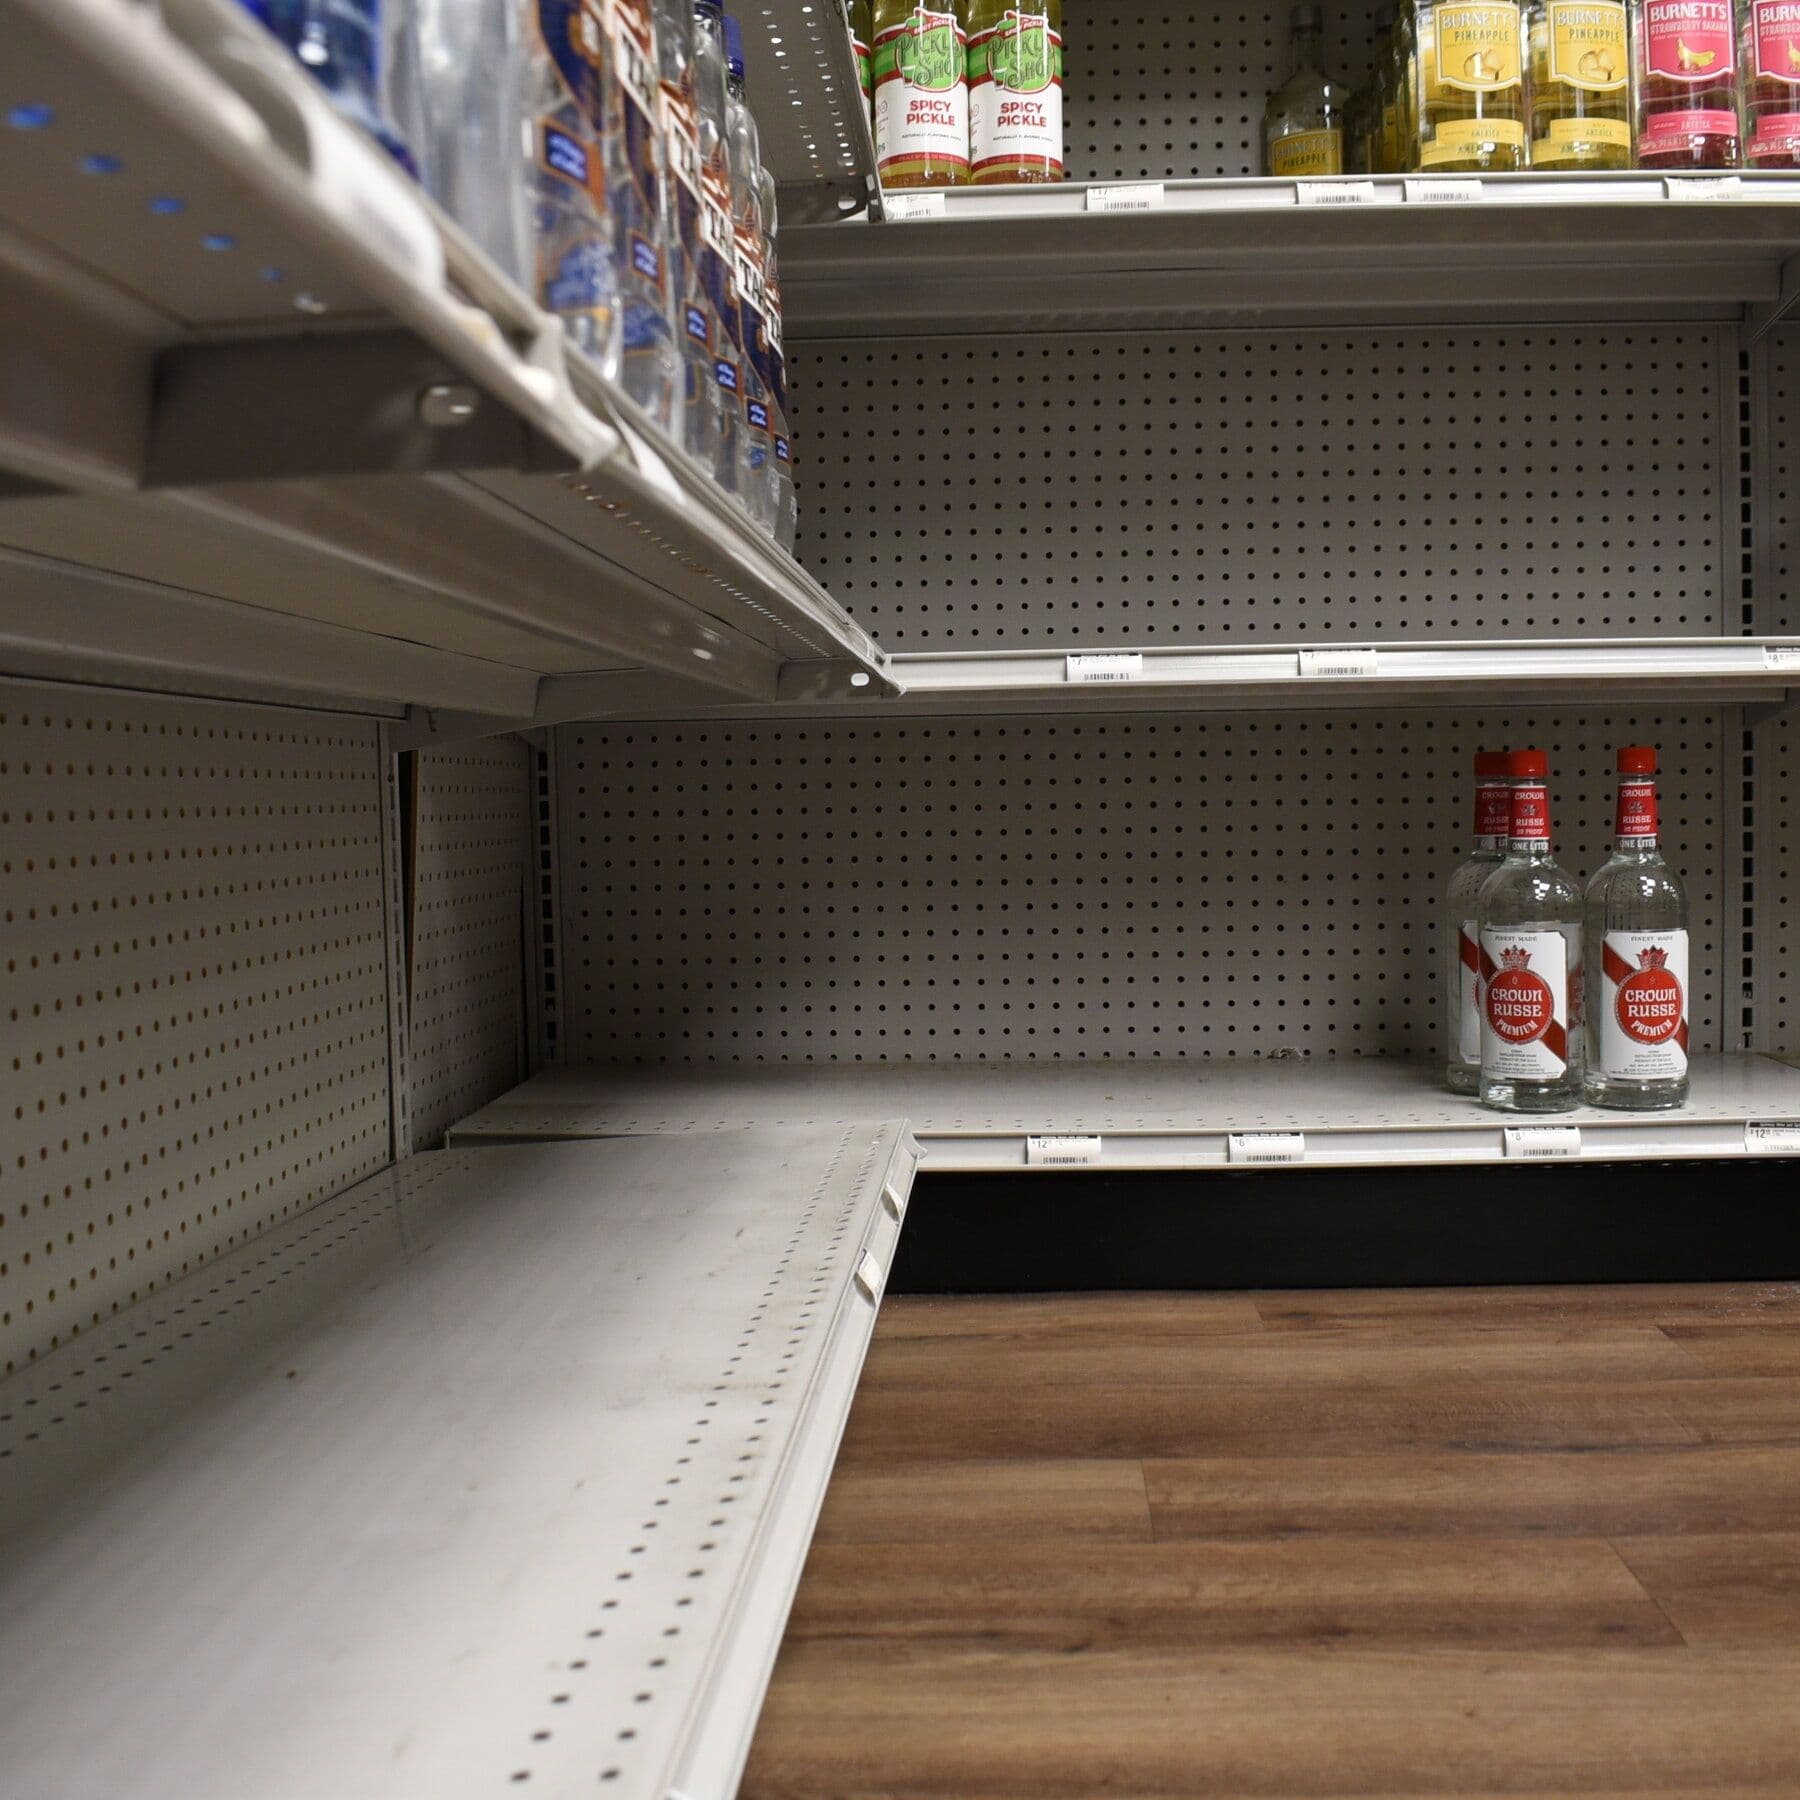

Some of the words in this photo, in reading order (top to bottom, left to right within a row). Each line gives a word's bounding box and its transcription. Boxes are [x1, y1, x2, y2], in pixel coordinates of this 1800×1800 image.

[1454, 30, 1509, 42] PINEAPPLE
[1569, 28, 1620, 42] PINEAPPLE
[909, 100, 951, 112] SPICY
[1001, 102, 1042, 113] SPICY
[906, 113, 955, 126] PICKLE
[997, 115, 1046, 127] PICKLE
[1514, 791, 1545, 800] CROWN
[1622, 789, 1652, 798] CROWN
[1515, 818, 1545, 827] RUSSE
[1622, 815, 1652, 824] RUSSE
[1512, 841, 1529, 850] ONE
[1530, 840, 1549, 850] LITER
[1620, 839, 1635, 848] ONE
[1491, 988, 1543, 1002] CROWN
[1625, 987, 1677, 1002] CROWN
[1494, 1004, 1543, 1017] RUSSE
[1628, 1003, 1677, 1017] RUSSE
[1496, 1019, 1538, 1036] PREMIUM
[1630, 1019, 1673, 1036] PREMIUM
